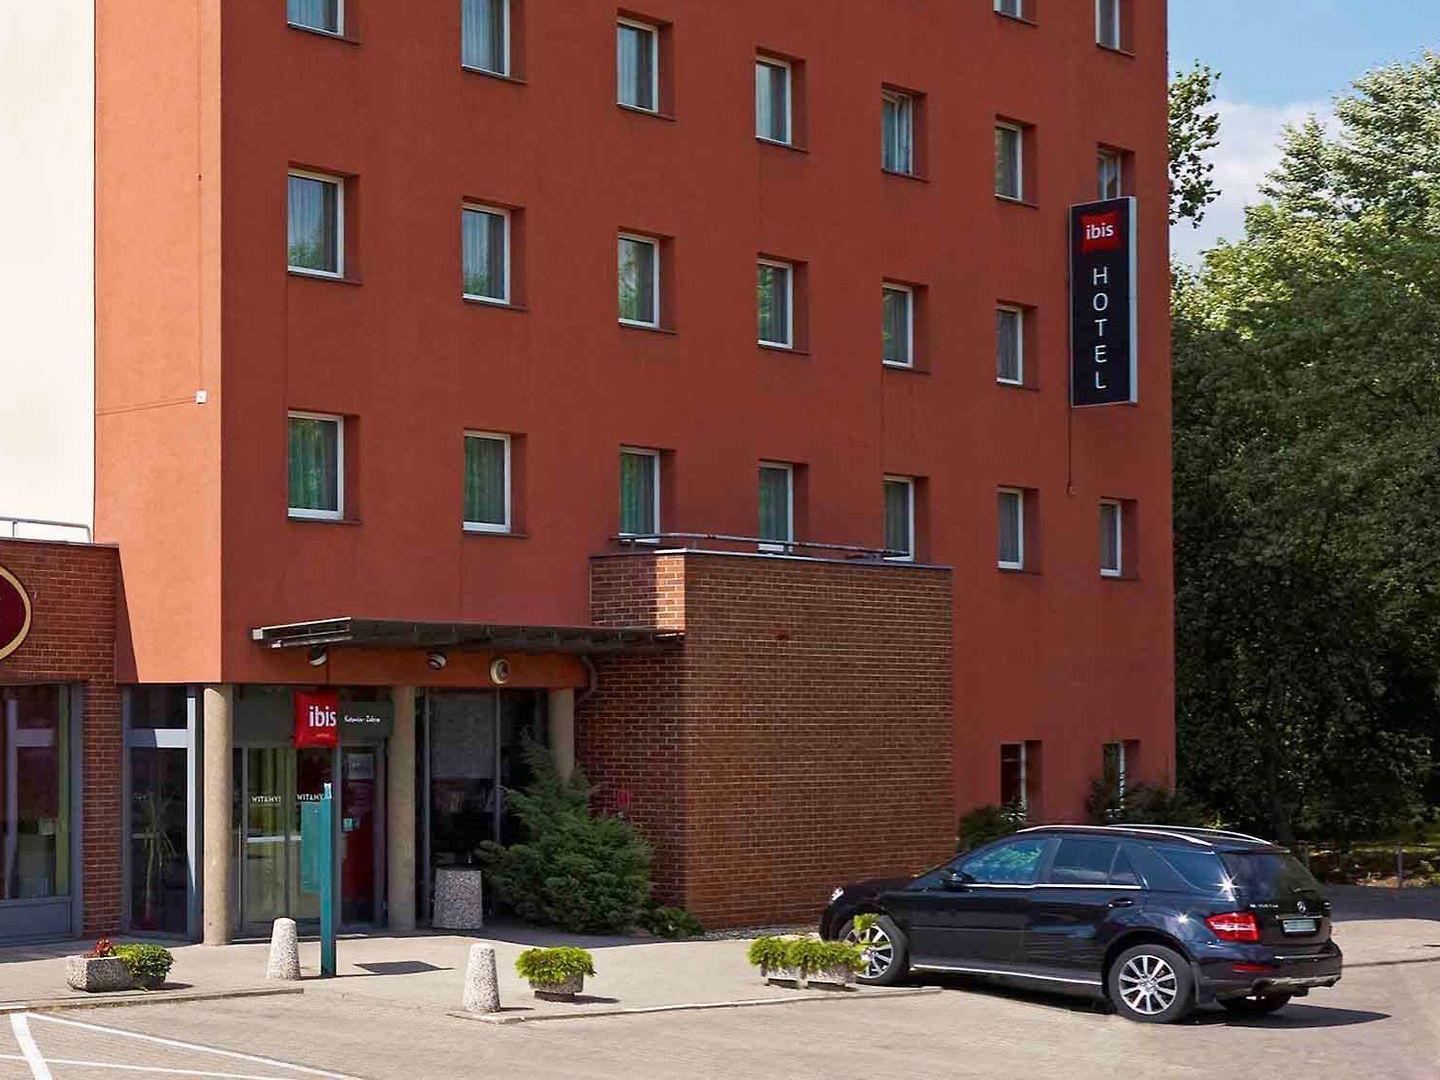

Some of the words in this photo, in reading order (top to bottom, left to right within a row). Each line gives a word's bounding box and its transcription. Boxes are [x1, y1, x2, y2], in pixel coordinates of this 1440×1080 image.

[1086, 223, 1114, 240] ibis
[1093, 266, 1108, 389] HOTEL
[309, 705, 337, 727] ibis
